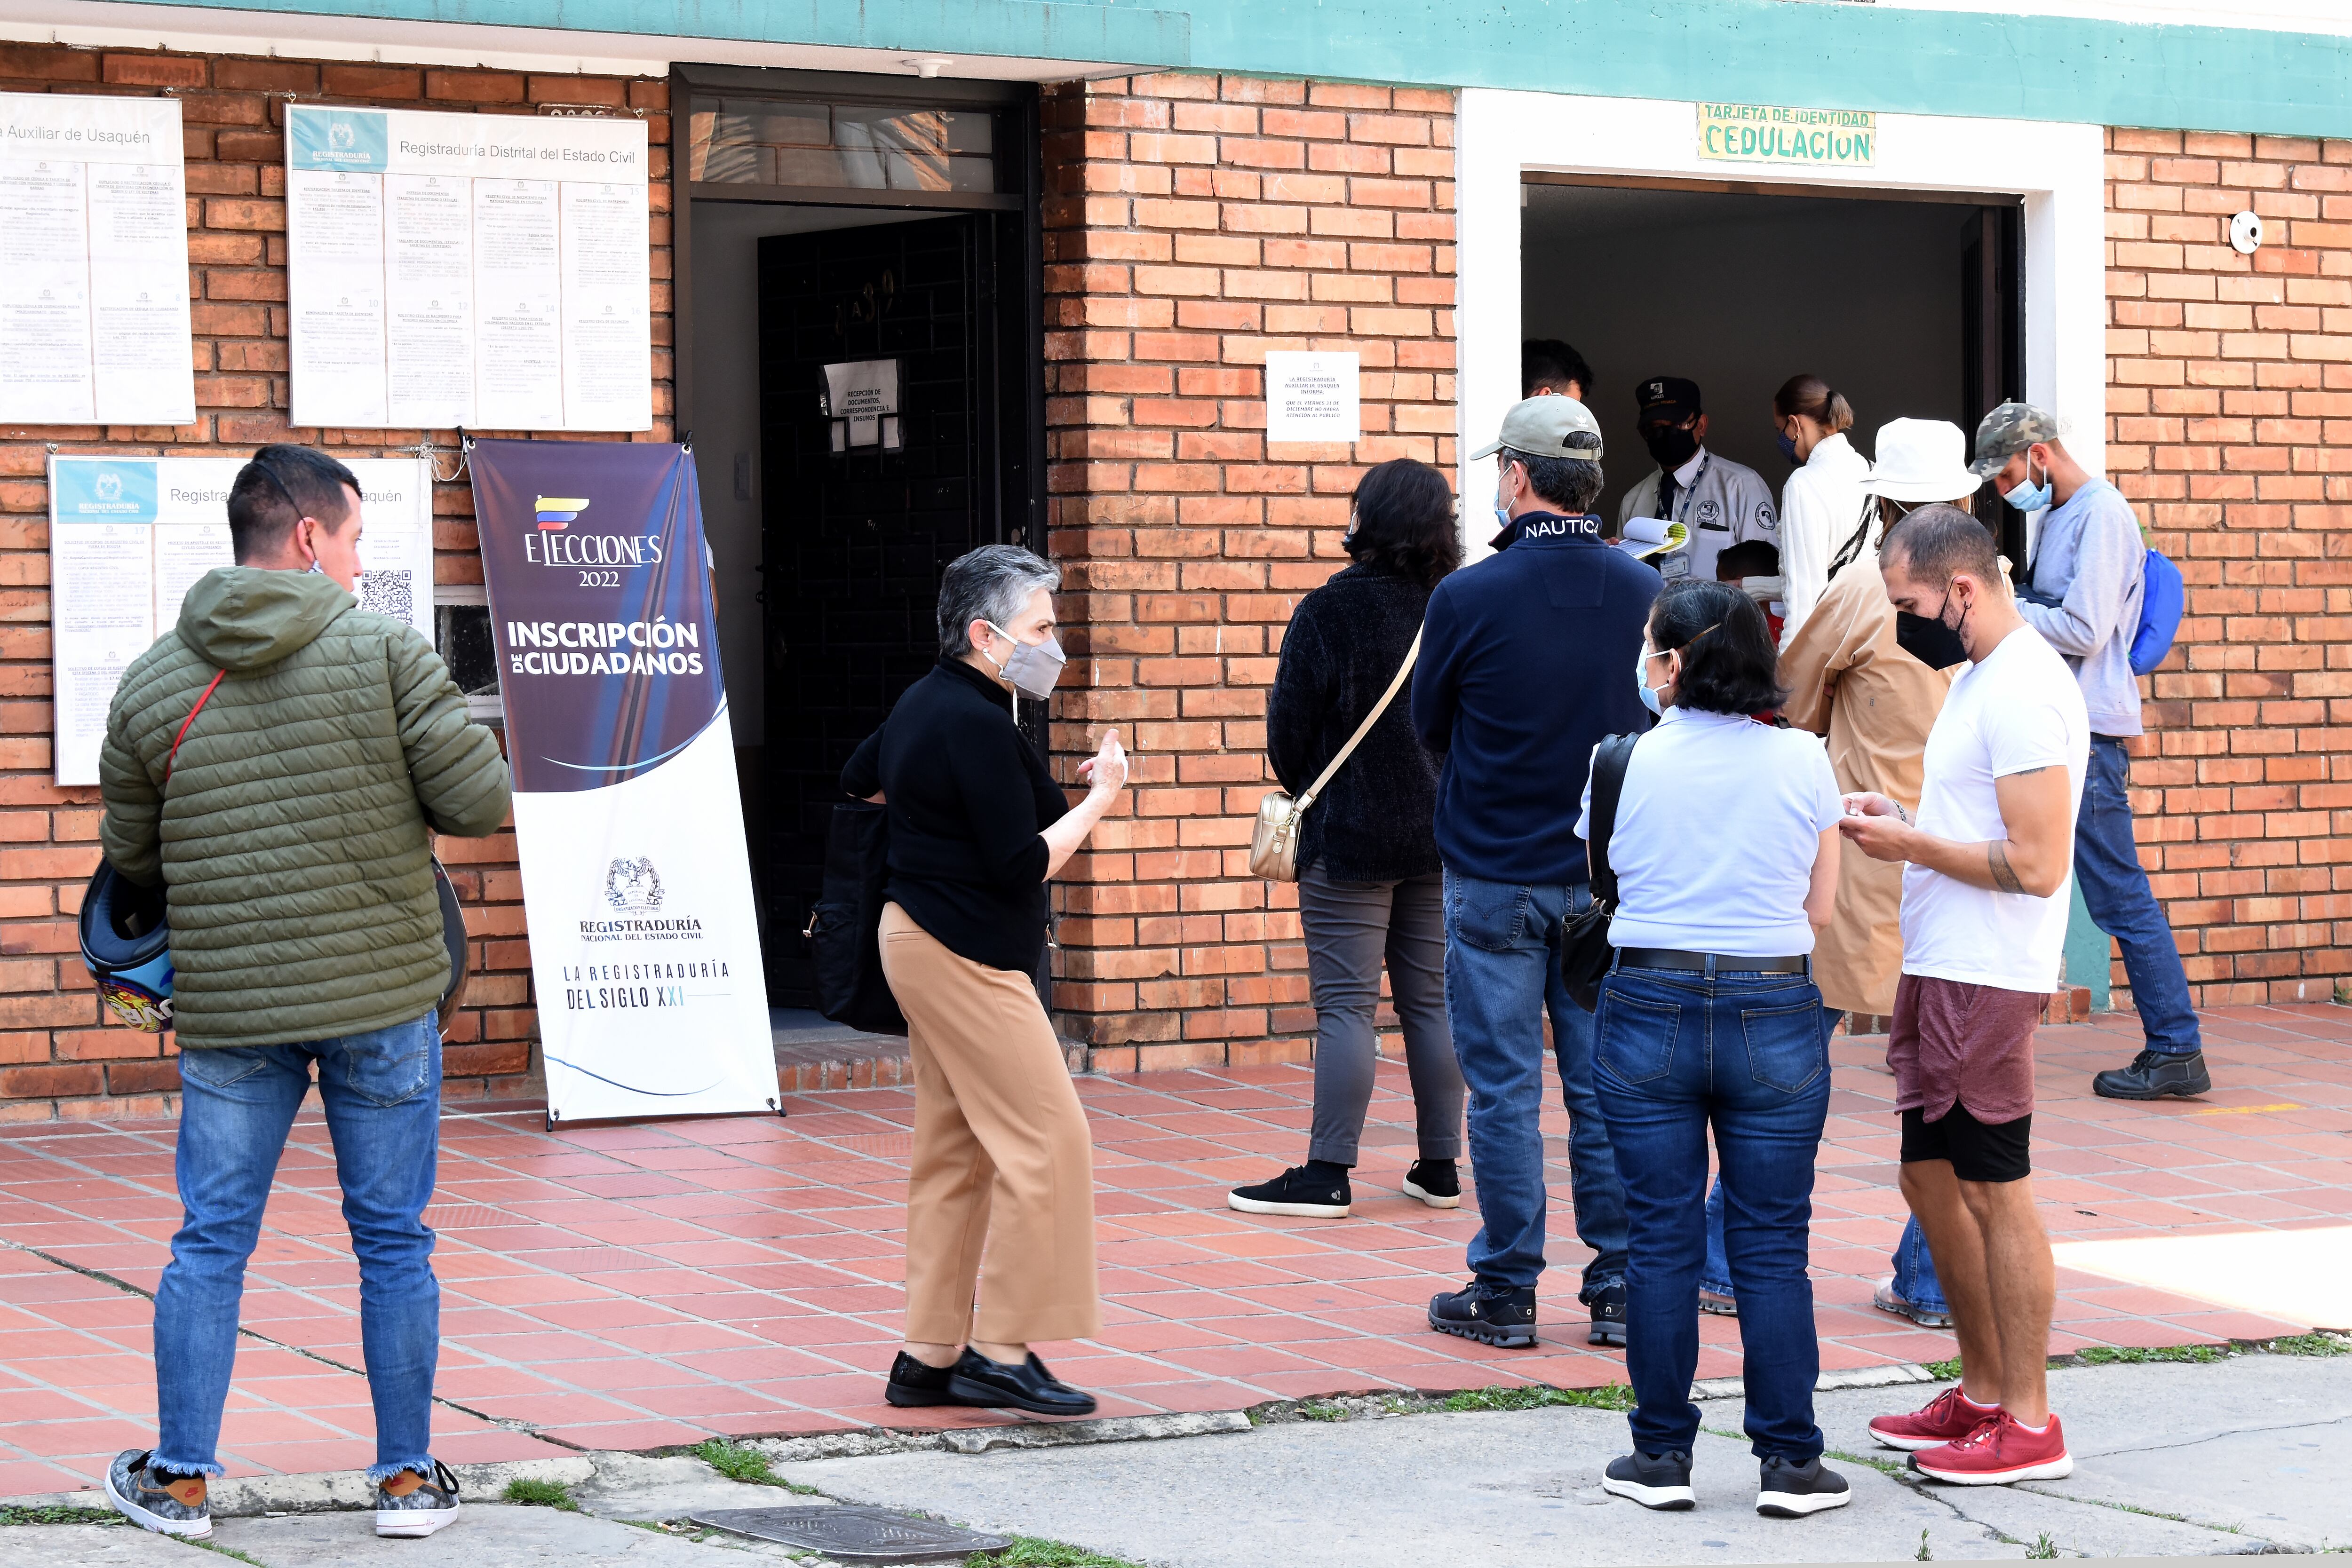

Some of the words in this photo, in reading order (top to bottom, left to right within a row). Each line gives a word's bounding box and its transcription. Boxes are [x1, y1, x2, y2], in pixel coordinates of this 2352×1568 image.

[1706, 104, 1767, 120] TARJETA
[1773, 109, 1790, 121] DE
[1796, 110, 1868, 127] IDENTIDAD
[8, 125, 60, 139] Auxiliar
[65, 128, 81, 140] de
[87, 129, 150, 145] Usaquén
[401, 141, 485, 156] Registraduría
[490, 145, 536, 158] Distrital
[540, 148, 558, 160] del
[564, 149, 605, 162] Estado
[610, 151, 635, 163] Civil
[171, 489, 229, 504] Registra
[362, 490, 401, 504] aquén
[525, 530, 663, 564] ELECCIONES
[579, 571, 620, 586] 2022
[508, 615, 699, 648] INSCRIPCIÓN
[511, 654, 524, 673] DE
[524, 652, 704, 675] CIUDADANOS
[580, 915, 702, 932] REGISTRADURÍA
[564, 966, 580, 981] LA
[590, 959, 729, 981] REGISTRADURÍA
[567, 989, 595, 1009] DEL
[599, 987, 649, 1008] SIGLO
[657, 986, 683, 1006] XXI
